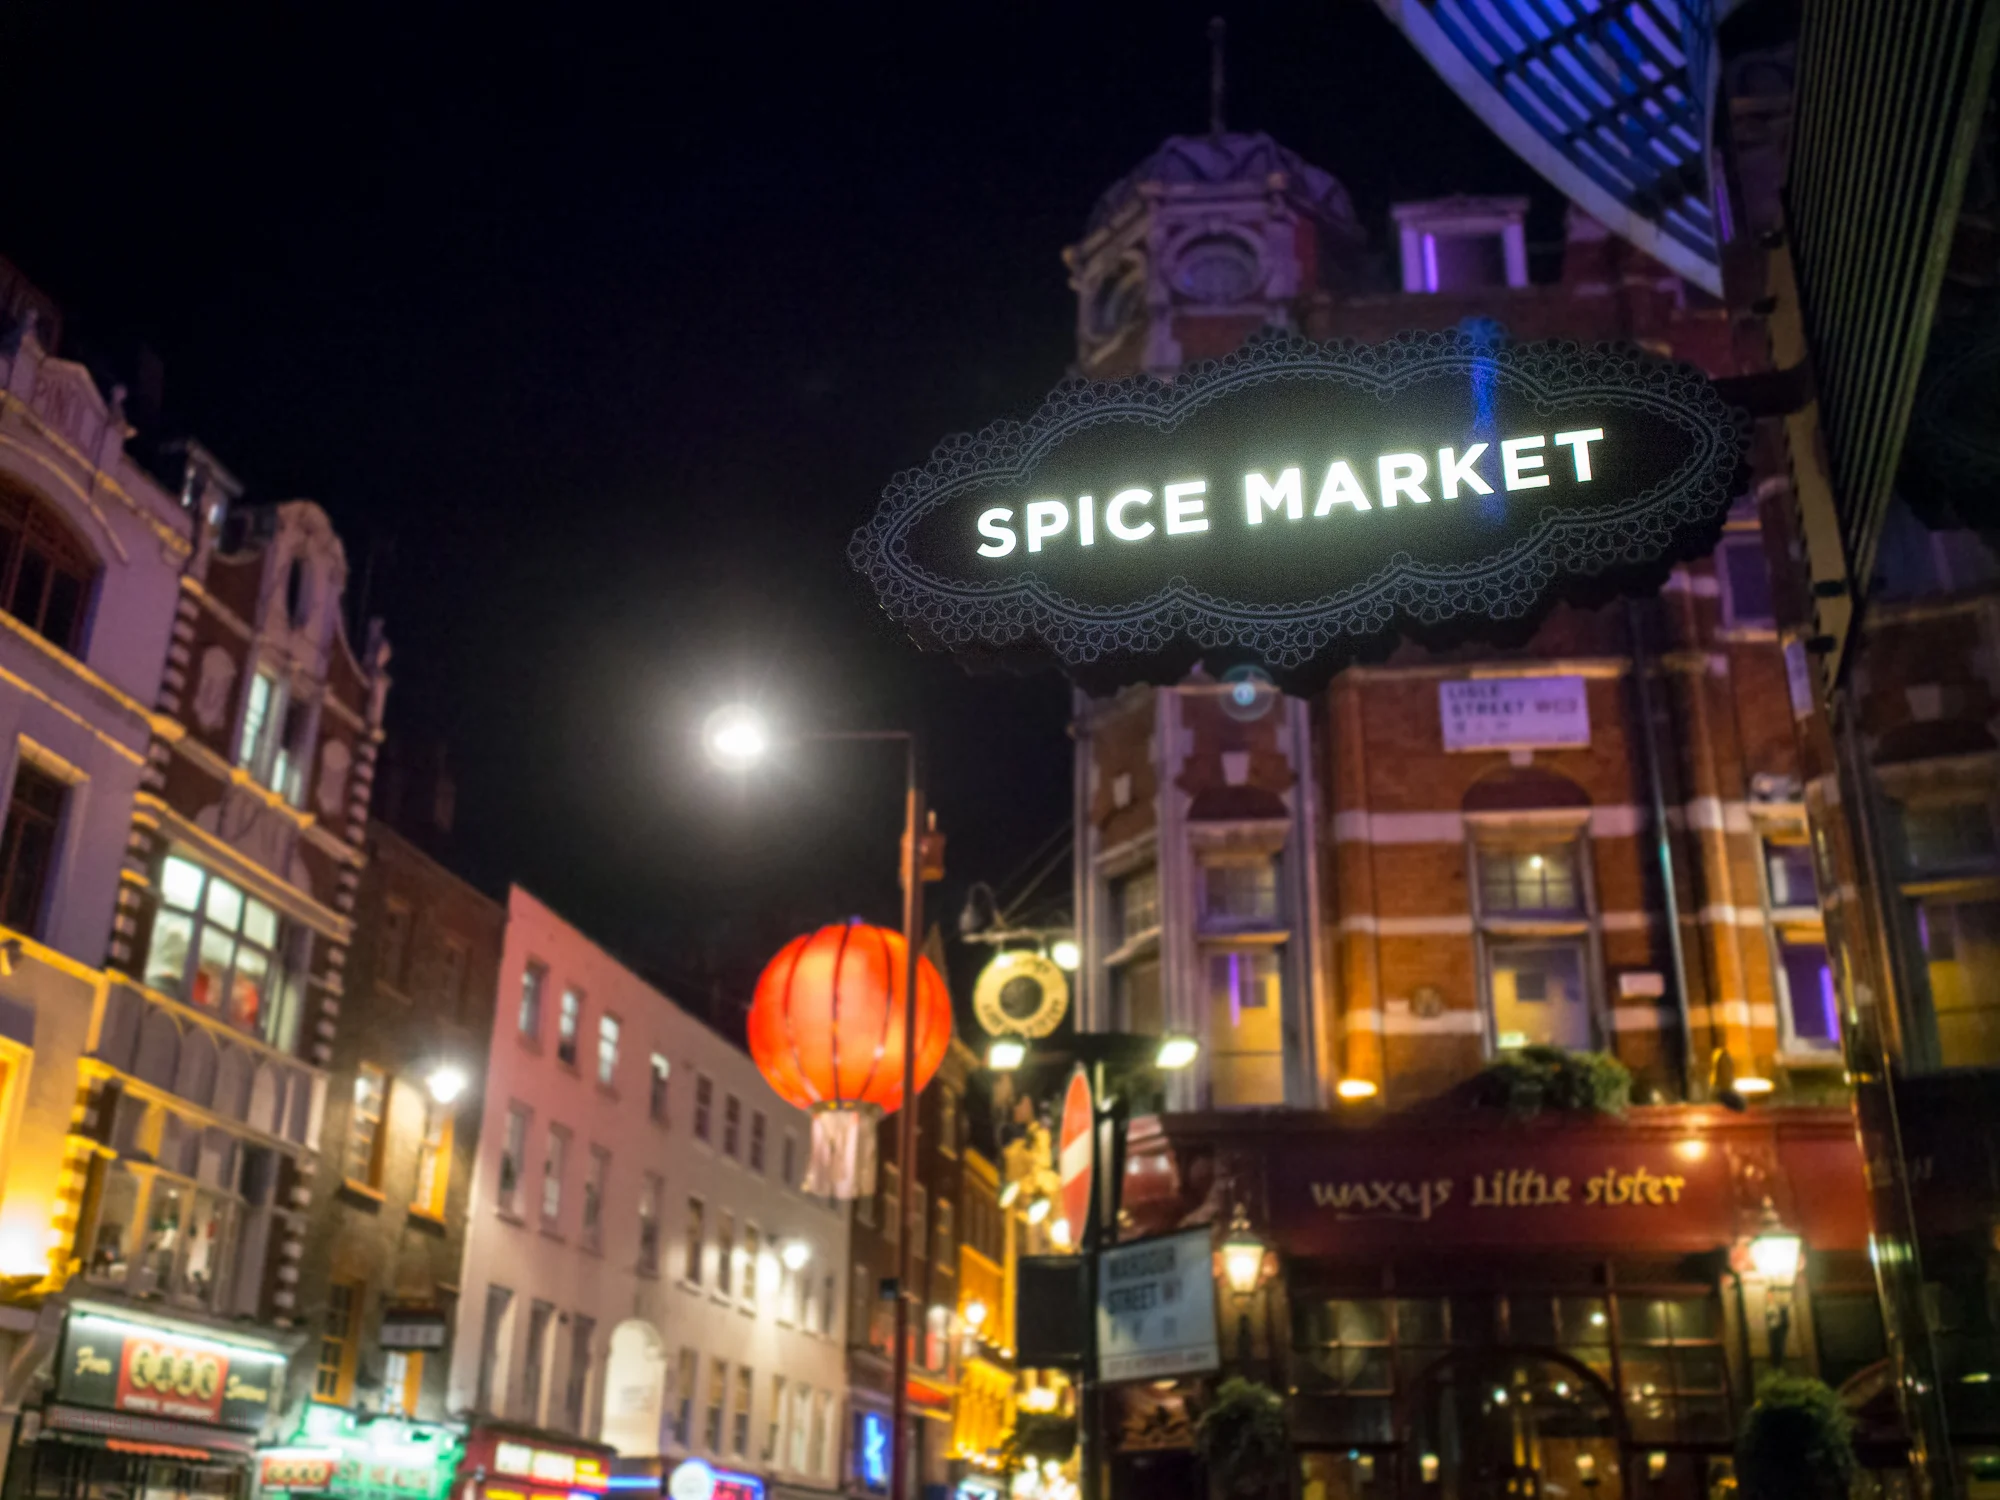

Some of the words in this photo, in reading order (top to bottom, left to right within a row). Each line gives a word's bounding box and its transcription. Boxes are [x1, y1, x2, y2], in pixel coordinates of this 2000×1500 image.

[976, 480, 1210, 558] SPICE
[1243, 427, 1604, 526] MARKET
[1585, 1165, 1686, 1205] sister
[1108, 1281, 1157, 1314] STREET
